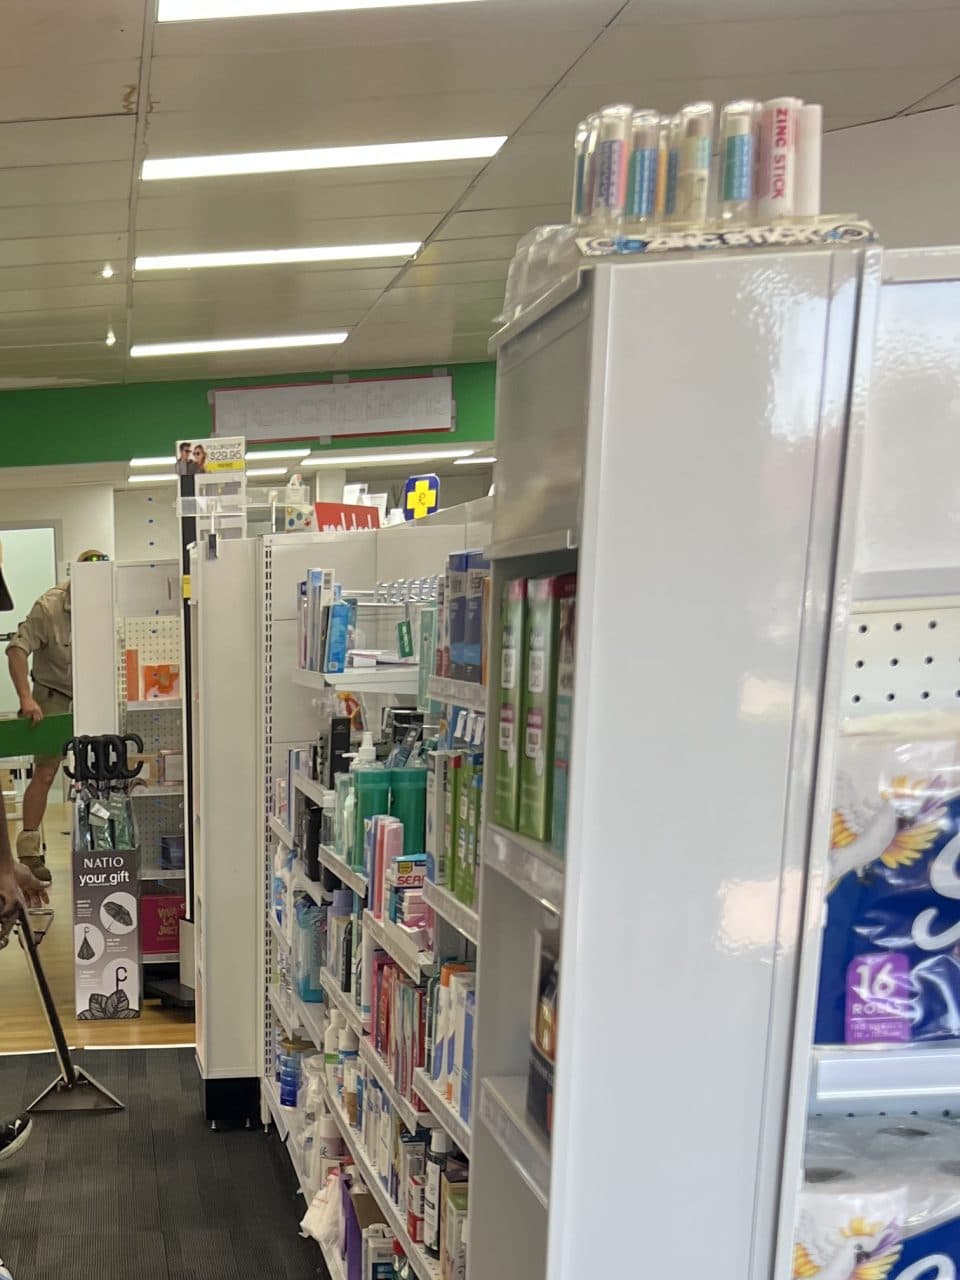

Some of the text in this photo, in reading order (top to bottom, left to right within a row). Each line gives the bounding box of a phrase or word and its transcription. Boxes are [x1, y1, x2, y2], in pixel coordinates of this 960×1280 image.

[770, 107, 788, 200] ZINC STICK
[83, 856, 124, 868] NATIO
[79, 870, 130, 886] your gift
[855, 962, 896, 998] 16
